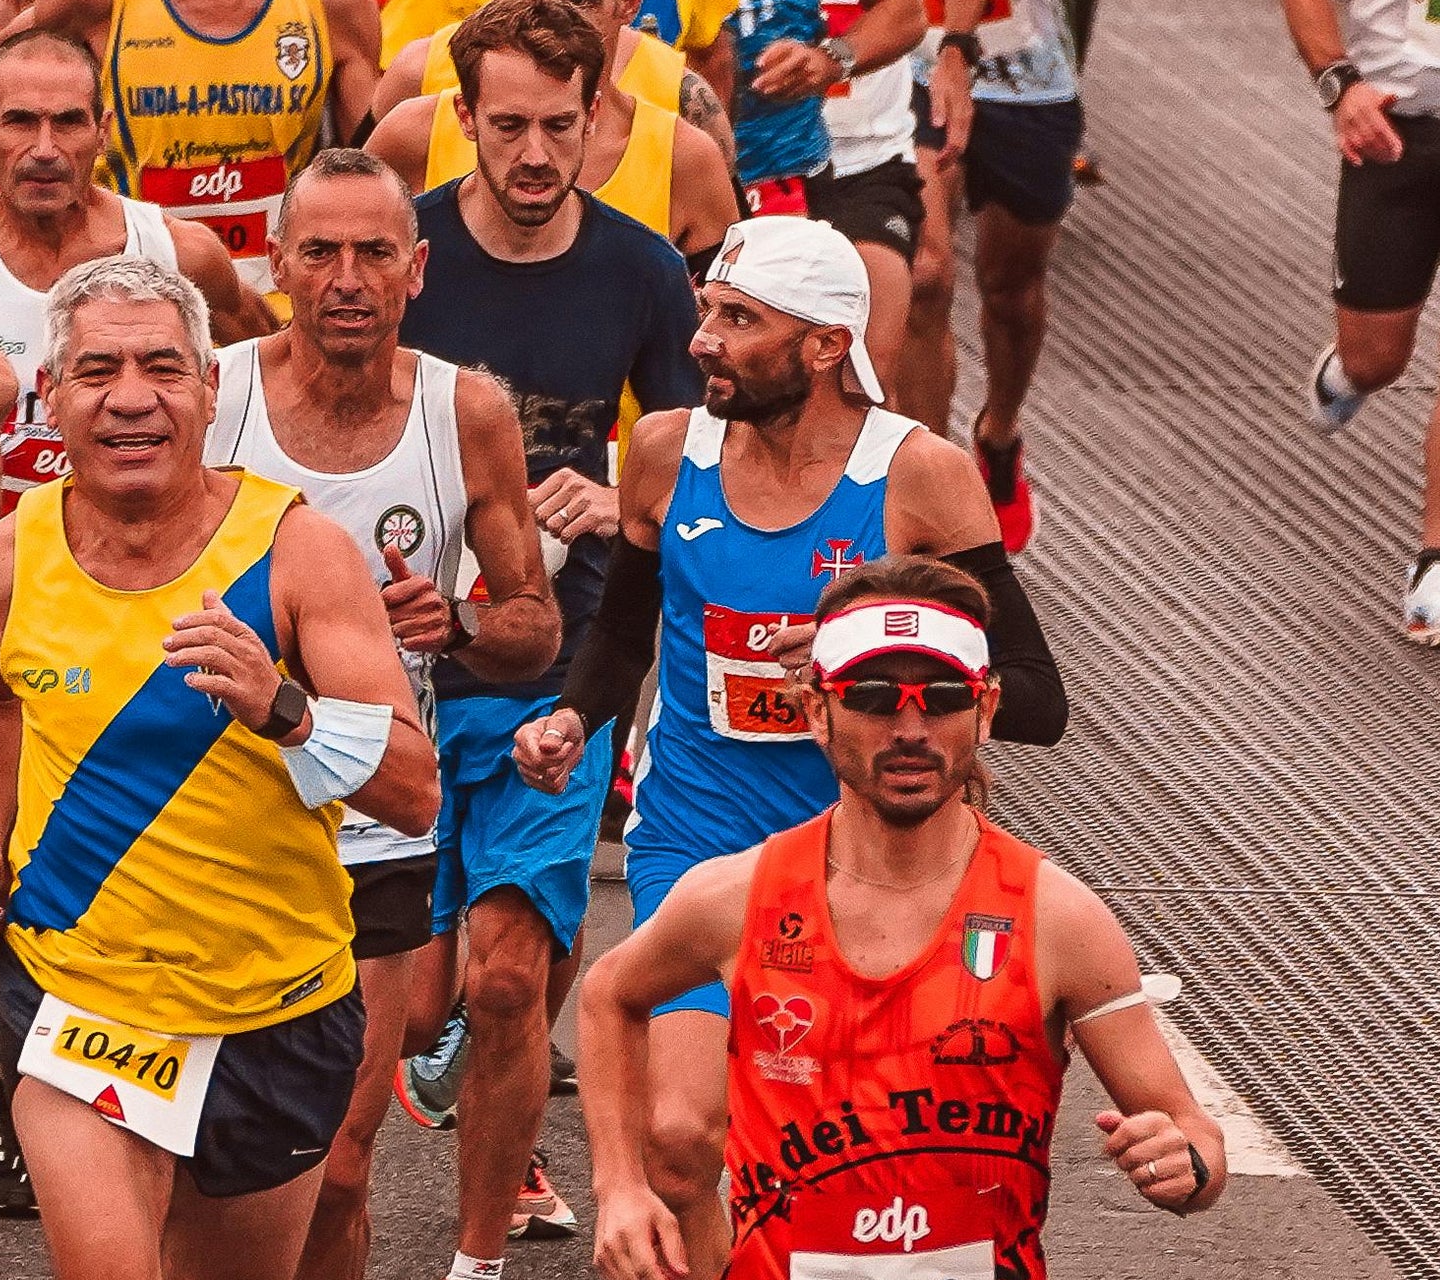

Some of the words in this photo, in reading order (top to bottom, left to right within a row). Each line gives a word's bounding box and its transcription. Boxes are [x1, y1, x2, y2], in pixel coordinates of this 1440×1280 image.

[189, 165, 244, 202] edp
[61, 1025, 179, 1090] 10410
[779, 1101, 873, 1171] dei
[888, 1087, 1053, 1161] Temp
[851, 1195, 931, 1253] edp
